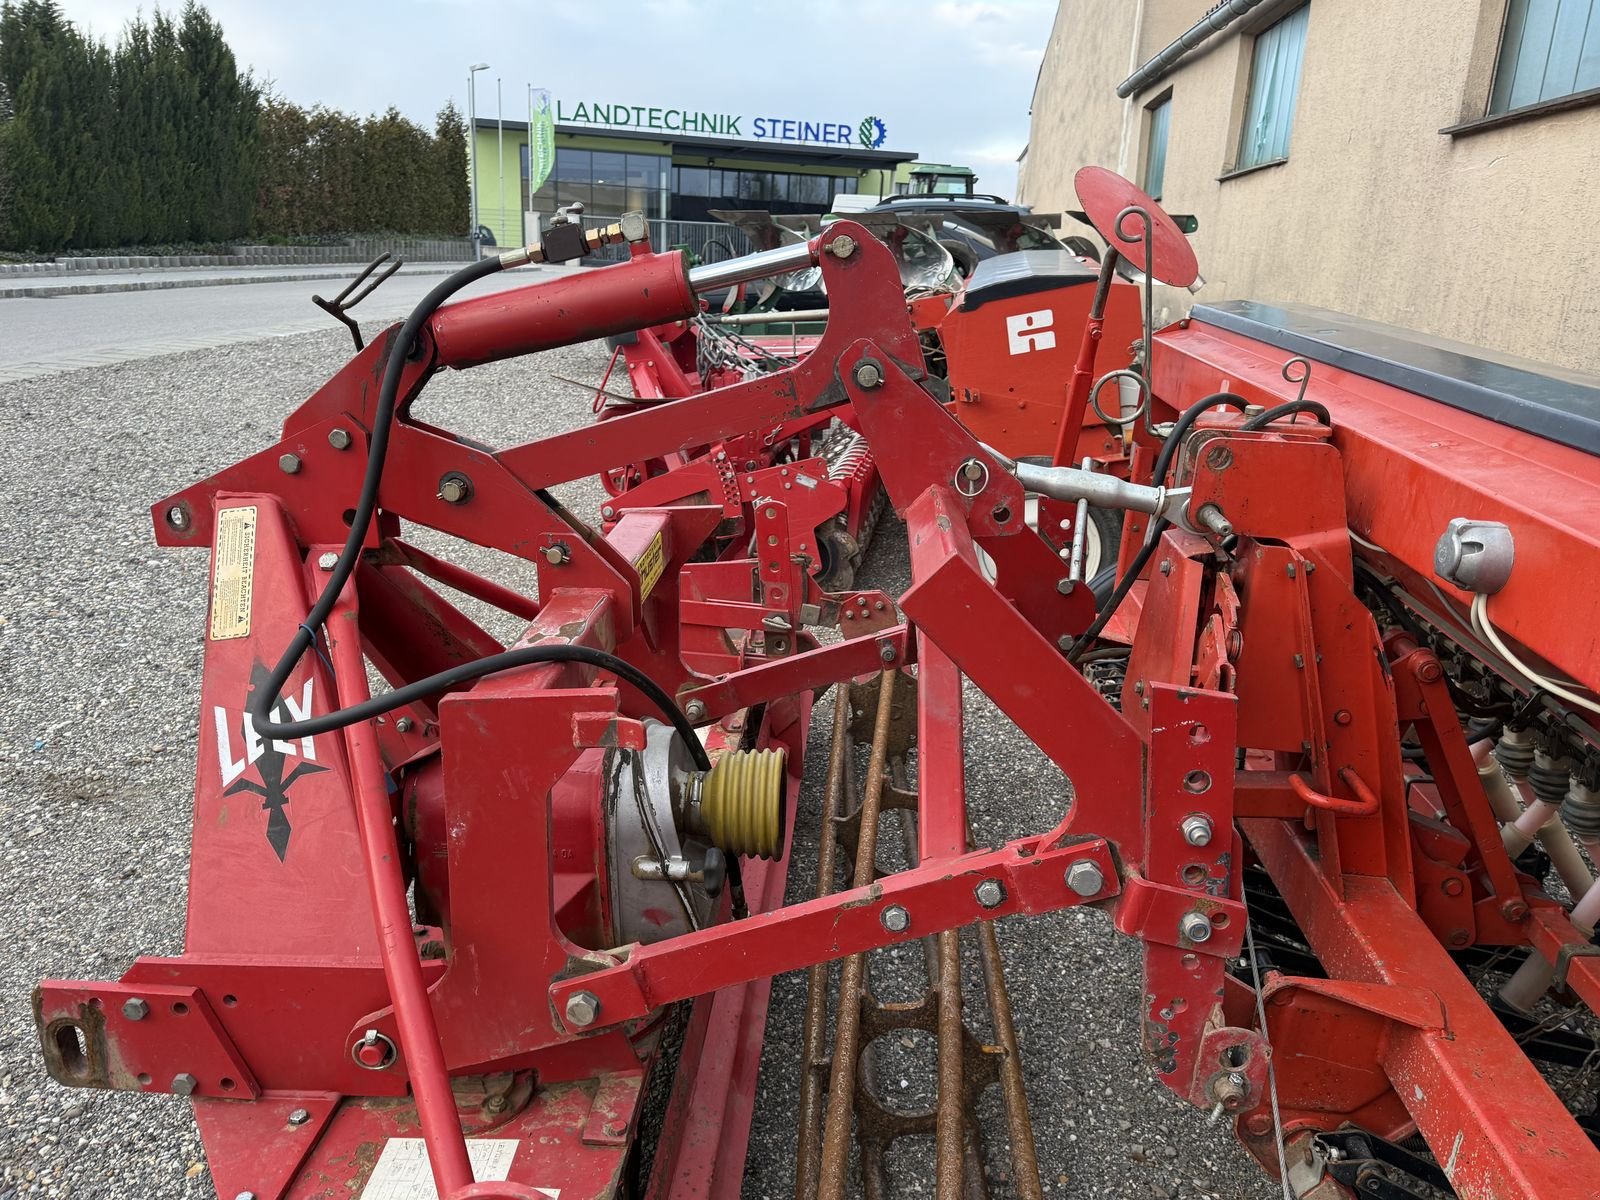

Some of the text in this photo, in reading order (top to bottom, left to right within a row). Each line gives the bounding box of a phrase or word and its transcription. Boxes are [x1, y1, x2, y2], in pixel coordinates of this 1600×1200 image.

[557, 100, 852, 145] LANDTECHNIK STEINER
[239, 531, 251, 613] SICHERHEIT BEACHTEN
